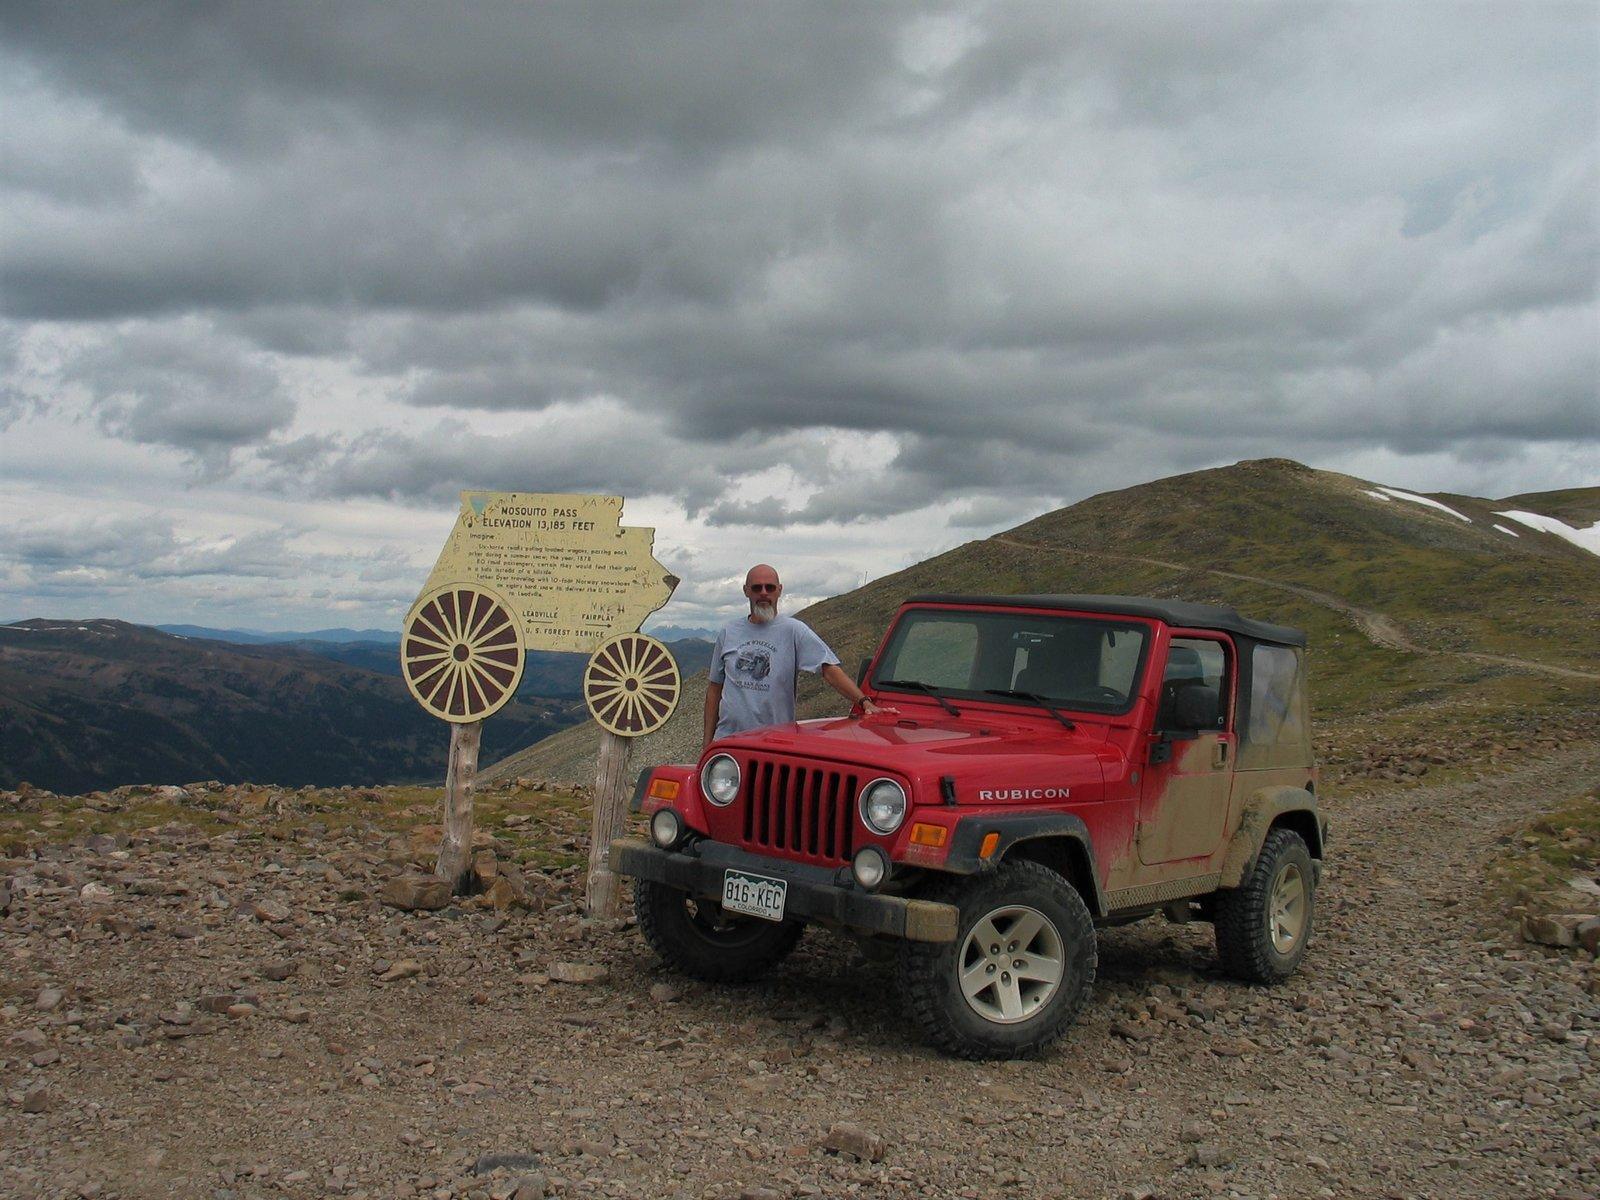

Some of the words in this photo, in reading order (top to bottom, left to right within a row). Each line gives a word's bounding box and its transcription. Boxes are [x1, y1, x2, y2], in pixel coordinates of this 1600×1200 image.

[501, 506, 547, 516] MOSQUITO
[553, 508, 578, 518] PASS
[483, 518, 531, 529] ELEVATION
[537, 520, 565, 531] 13,185
[572, 521, 595, 531] FEET
[575, 578, 599, 586] Norway
[522, 610, 558, 619] LEADVILLE
[581, 613, 615, 621] FAIRPLAY
[575, 630, 605, 638] SERVICE
[979, 788, 1070, 800] RUBICON
[737, 903, 768, 914] COLORADO
